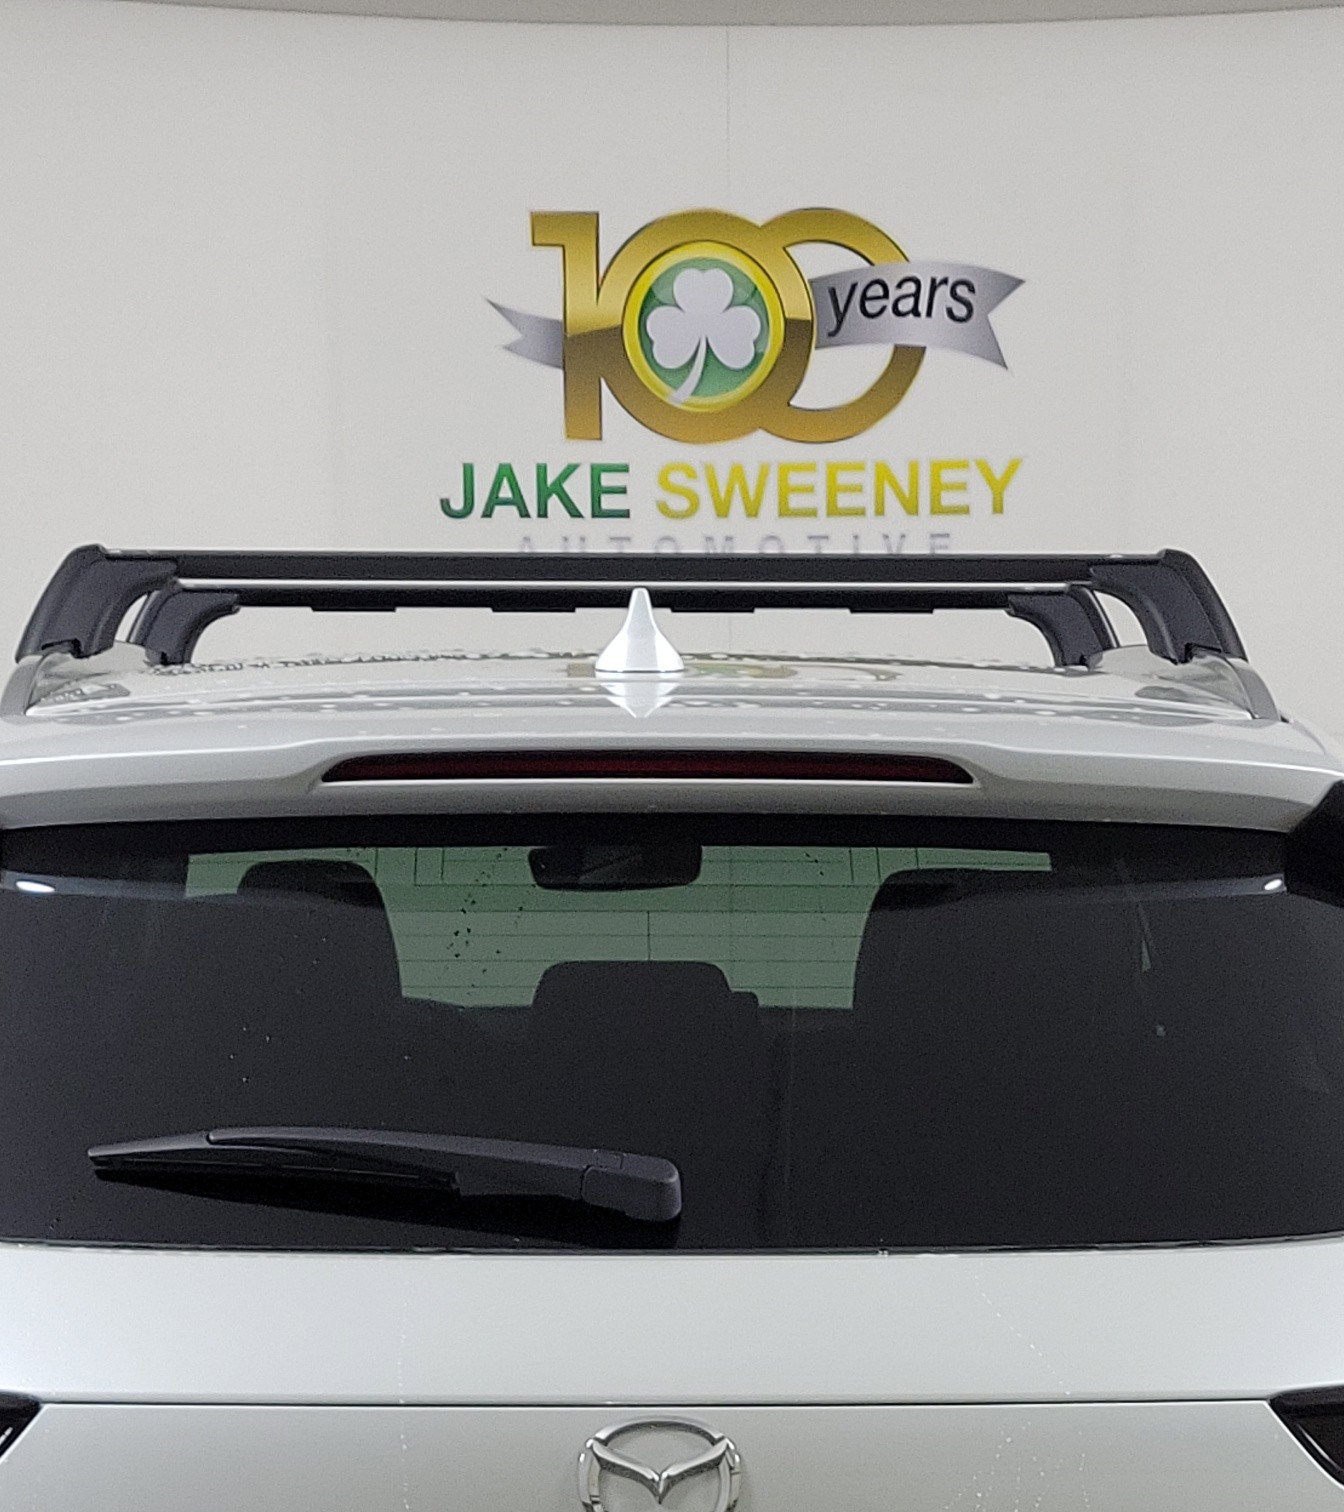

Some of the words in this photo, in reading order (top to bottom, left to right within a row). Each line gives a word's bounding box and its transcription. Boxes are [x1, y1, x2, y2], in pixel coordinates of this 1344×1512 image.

[530, 206, 927, 444] 100
[827, 277, 976, 337] years
[439, 462, 631, 520] JAKE
[655, 457, 1025, 519] SWEENEY
[519, 532, 952, 554] AUTOMOTIVE
